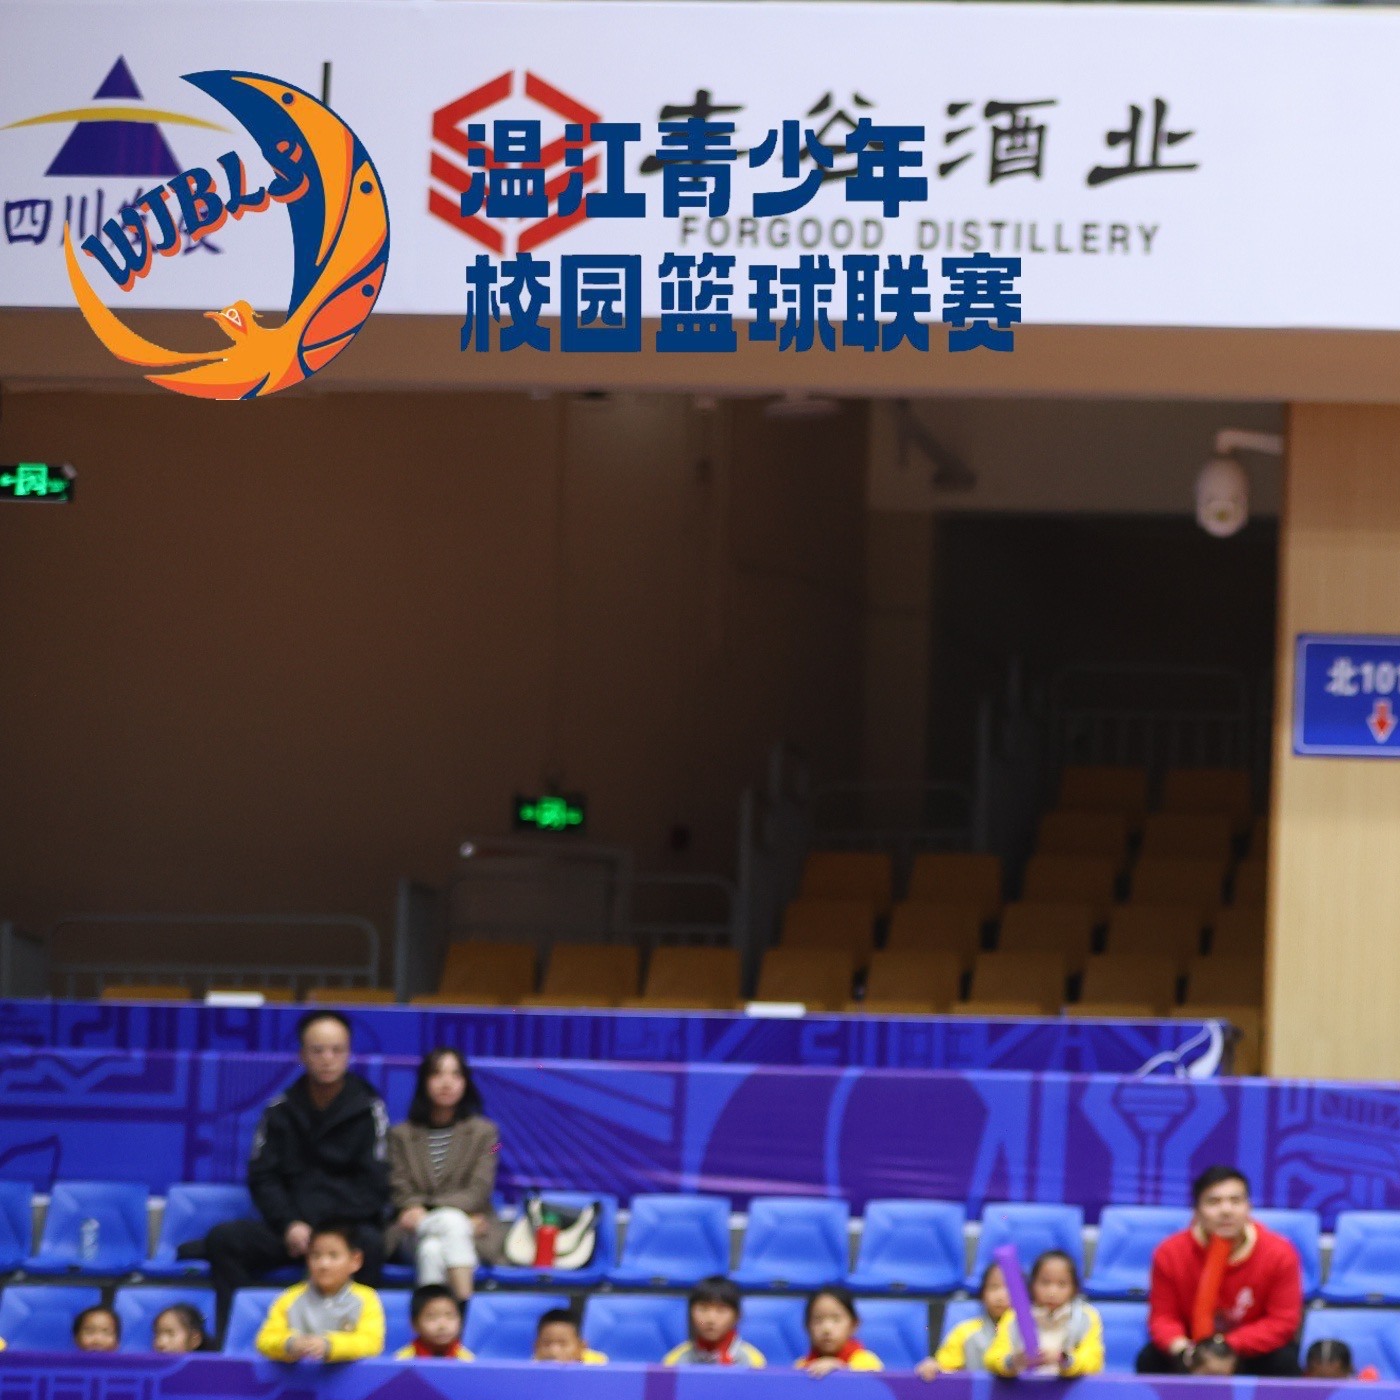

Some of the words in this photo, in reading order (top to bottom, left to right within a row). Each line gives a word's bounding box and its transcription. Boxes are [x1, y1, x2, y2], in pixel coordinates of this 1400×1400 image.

[4, 187, 224, 256] 四川
[678, 216, 884, 251] FORGOOD
[917, 219, 1161, 255] DISTILLERY
